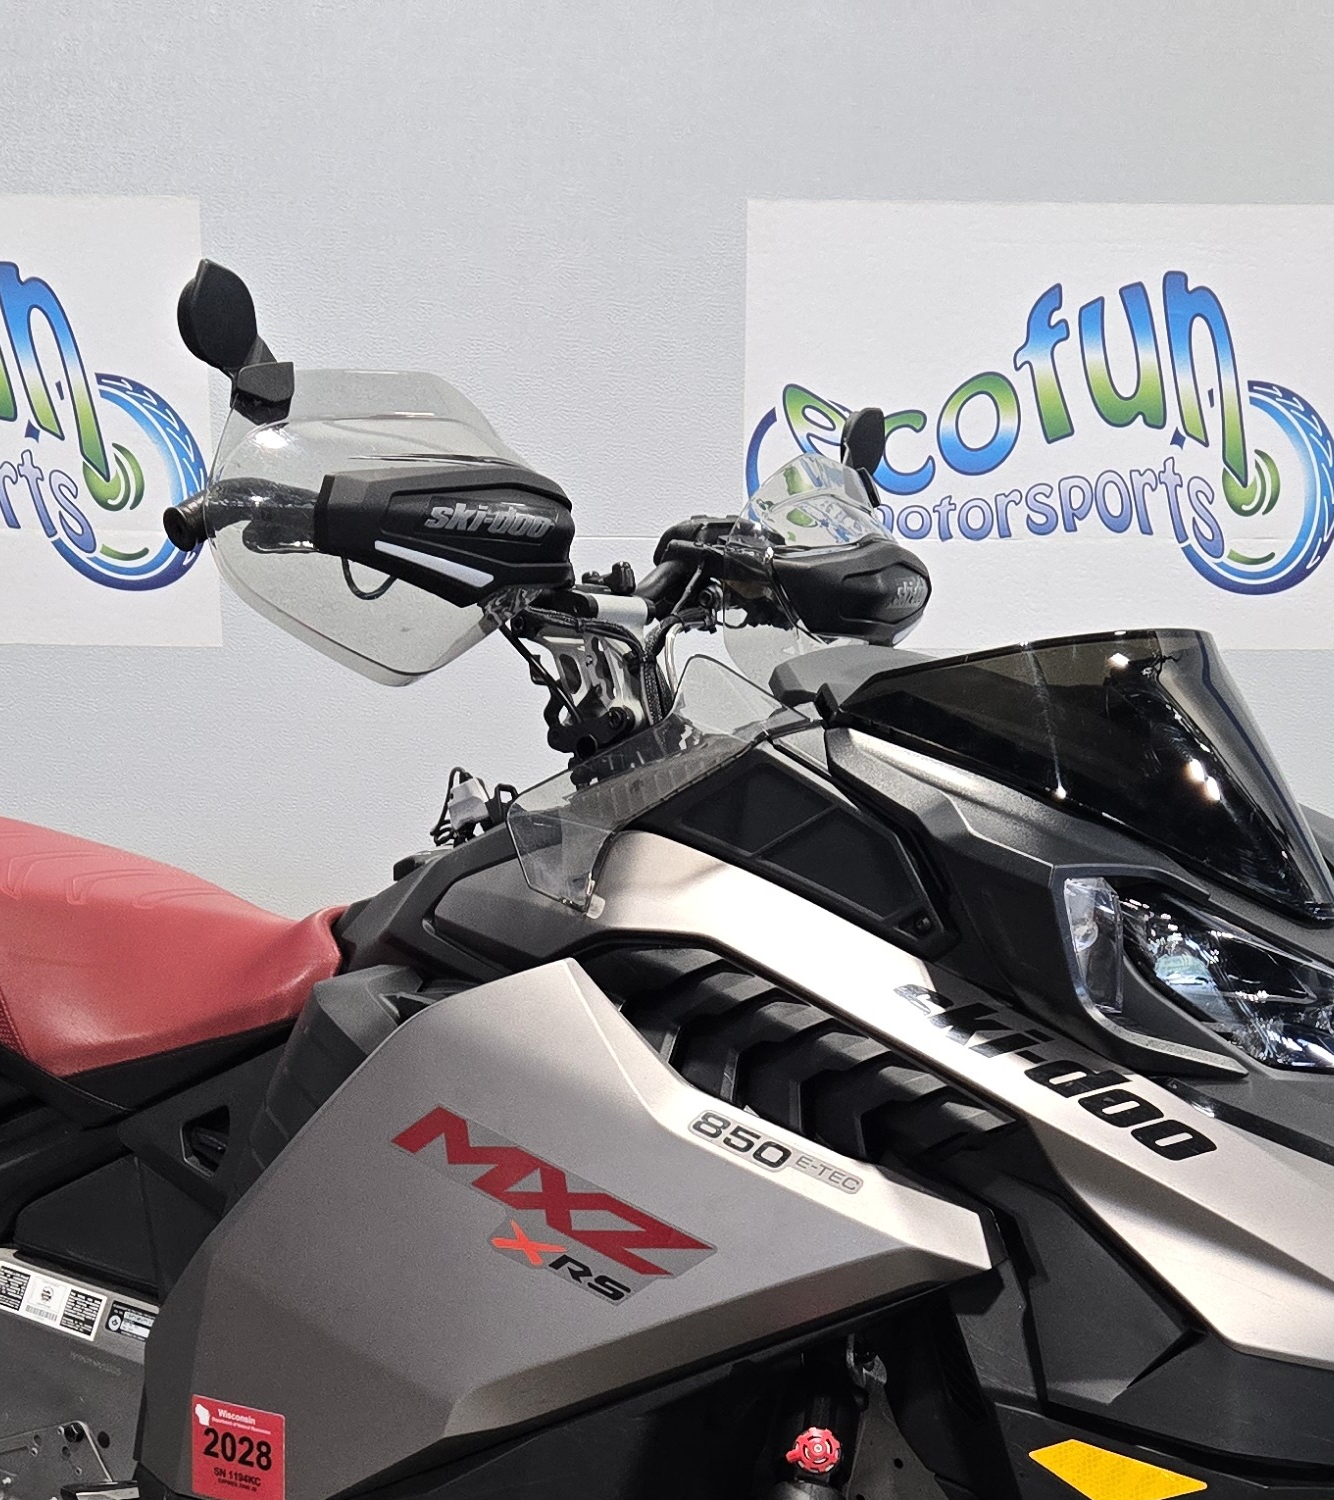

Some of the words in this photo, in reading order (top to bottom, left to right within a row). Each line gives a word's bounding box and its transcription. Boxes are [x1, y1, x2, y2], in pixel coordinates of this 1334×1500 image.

[424, 502, 553, 538] ski-doo
[876, 457, 1225, 560] otorsports
[893, 984, 1218, 1161] ski-doo
[390, 1106, 716, 1277] MXZ
[692, 1111, 792, 1169] 850
[795, 1155, 860, 1191] E-TEC
[203, 1428, 273, 1472] 2028
